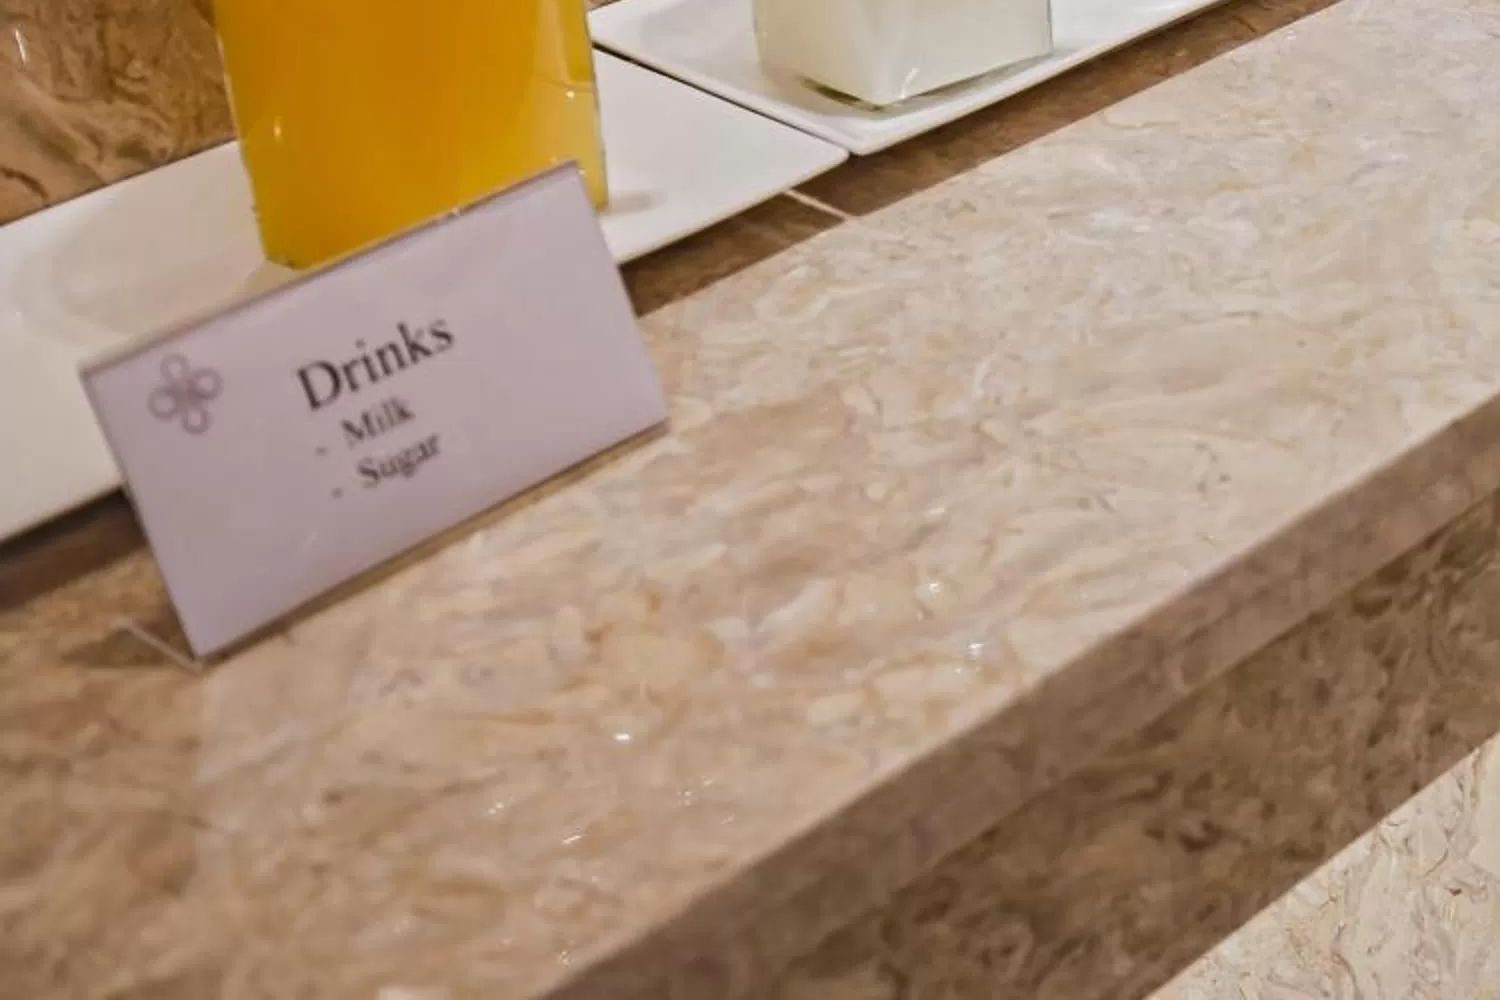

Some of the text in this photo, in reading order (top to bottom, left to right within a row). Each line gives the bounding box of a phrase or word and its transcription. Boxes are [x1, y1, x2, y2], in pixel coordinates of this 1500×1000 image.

[297, 320, 455, 411] Drinks
[340, 396, 416, 448] Milk
[356, 434, 441, 489] Sugar
